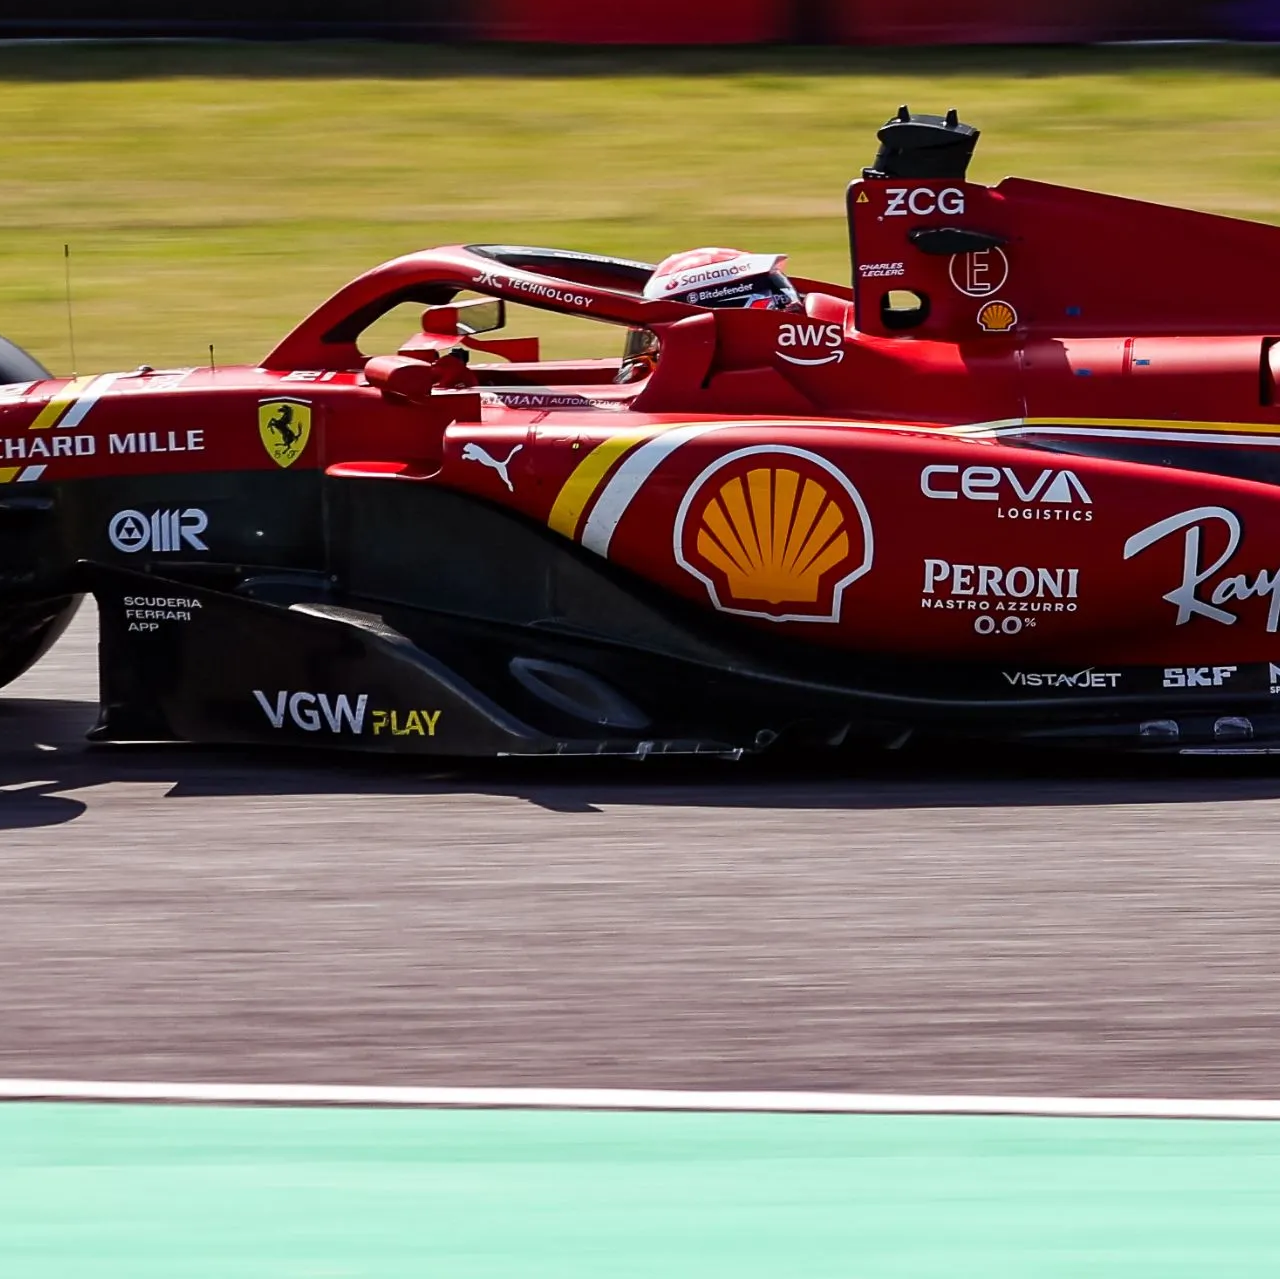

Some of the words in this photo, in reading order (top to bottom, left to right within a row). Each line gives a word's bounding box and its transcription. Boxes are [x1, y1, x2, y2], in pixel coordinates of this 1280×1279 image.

[681, 262, 752, 287] Santander
[859, 263, 904, 271] CHARLES
[862, 269, 905, 278] LECLERC
[507, 277, 594, 308] TECHNOLOGY
[699, 283, 754, 301] Bitdefender
[778, 324, 842, 347] aws
[482, 394, 545, 406] ARMAN
[109, 429, 205, 455] MILLE
[997, 507, 1093, 521] LOGISTICS
[922, 559, 1080, 598] PERONI
[123, 596, 203, 609] SCUDERIA
[921, 598, 990, 611] NASTRO
[995, 602, 1078, 612] AZZURRO
[126, 609, 191, 621] FERRARI
[128, 622, 160, 632] APP
[1002, 666, 1122, 689] VISTAJET
[1162, 666, 1237, 688] SKF
[252, 690, 369, 735] VGW
[372, 710, 442, 736] PLAY
